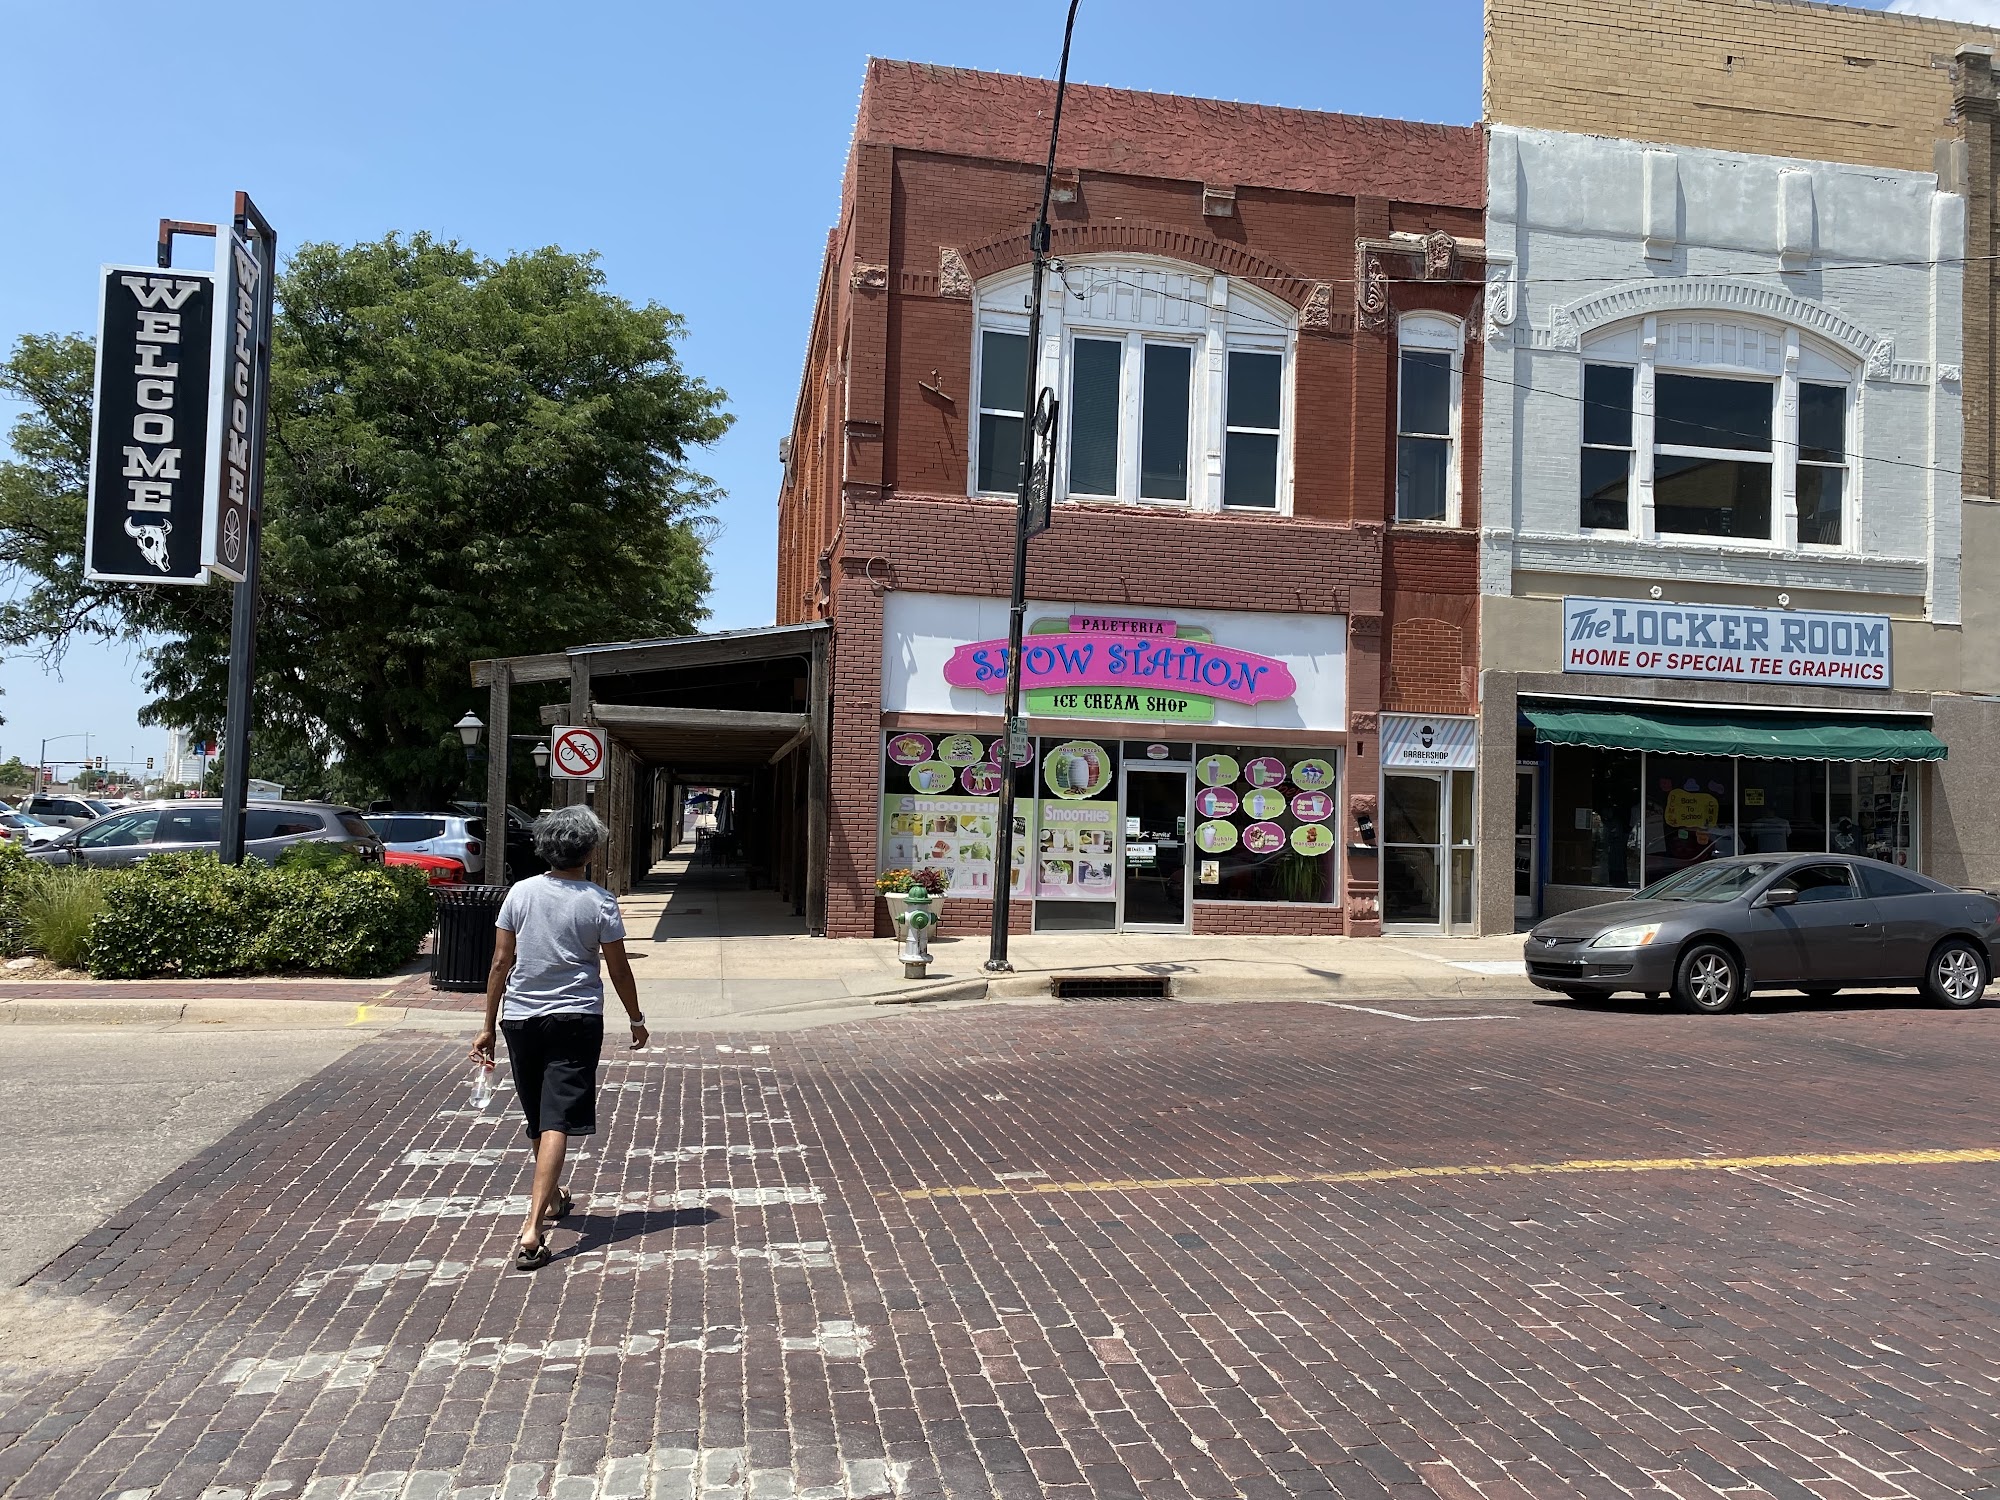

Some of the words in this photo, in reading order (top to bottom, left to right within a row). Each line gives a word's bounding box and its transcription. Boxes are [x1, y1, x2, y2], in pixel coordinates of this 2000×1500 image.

[228, 245, 259, 505] WELCOME
[121, 276, 200, 512] WELCOME
[1081, 618, 1165, 635] PALETERIA
[1570, 607, 1611, 641] The
[1612, 608, 1769, 652] LOCKER
[1780, 618, 1884, 658] ROOM
[1107, 640, 1269, 694] STATION
[1570, 648, 1631, 667] HOME
[1636, 651, 1663, 669] OF
[1666, 652, 1745, 673] SPECIAL
[1750, 658, 1784, 675] TEE
[1788, 659, 1885, 680] GRAPHICS
[1053, 693, 1078, 708] ICE
[1083, 693, 1141, 711] CREAM
[1147, 697, 1189, 713] SHOP
[1012, 719, 1018, 732] 2
[1403, 750, 1449, 760] BARBERSHOP
[1681, 797, 1698, 805] Back
